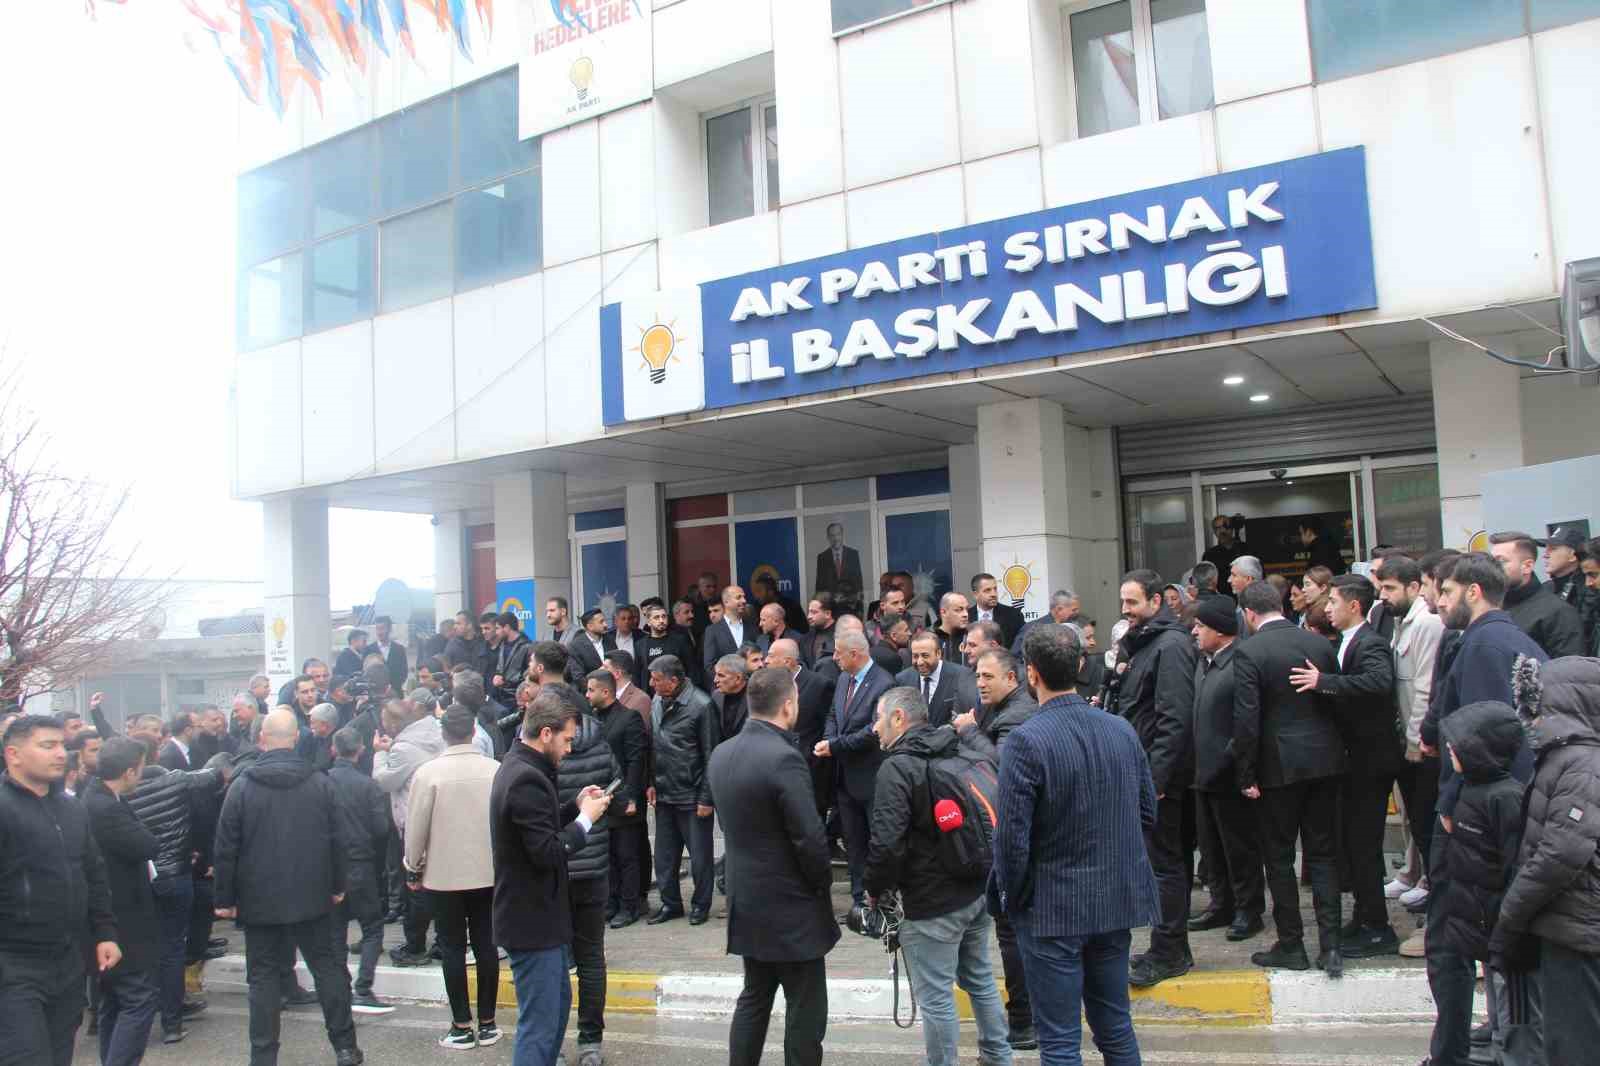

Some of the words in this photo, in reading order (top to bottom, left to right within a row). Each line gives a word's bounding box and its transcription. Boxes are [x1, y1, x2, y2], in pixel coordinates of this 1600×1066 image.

[729, 276, 813, 322] AK
[1003, 180, 1286, 273] ŞIRNAK
[792, 240, 1290, 375] BAŞKANLIĞI
